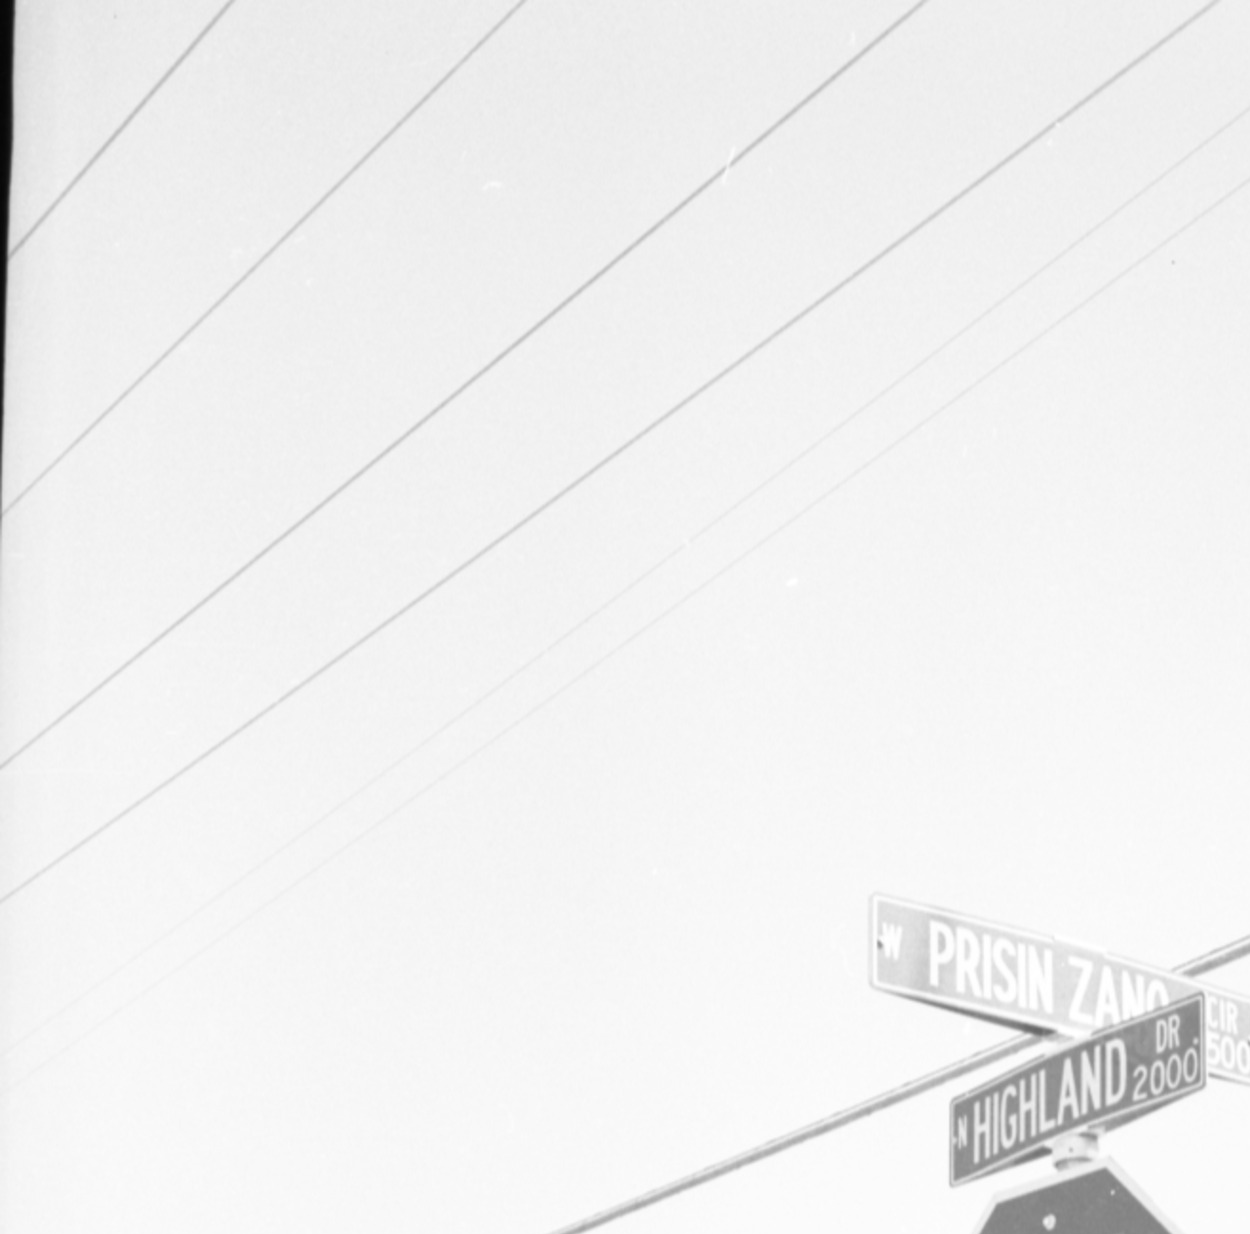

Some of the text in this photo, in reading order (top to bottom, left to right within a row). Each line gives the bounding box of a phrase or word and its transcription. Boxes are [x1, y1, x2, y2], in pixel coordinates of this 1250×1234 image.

[881, 923, 902, 961] W
[929, 920, 1053, 1014] PRISIN
[1207, 996, 1238, 1034] CIR
[957, 1014, 1180, 1164] N HIGHLAND DR
[1132, 1047, 1198, 1102] 2000
